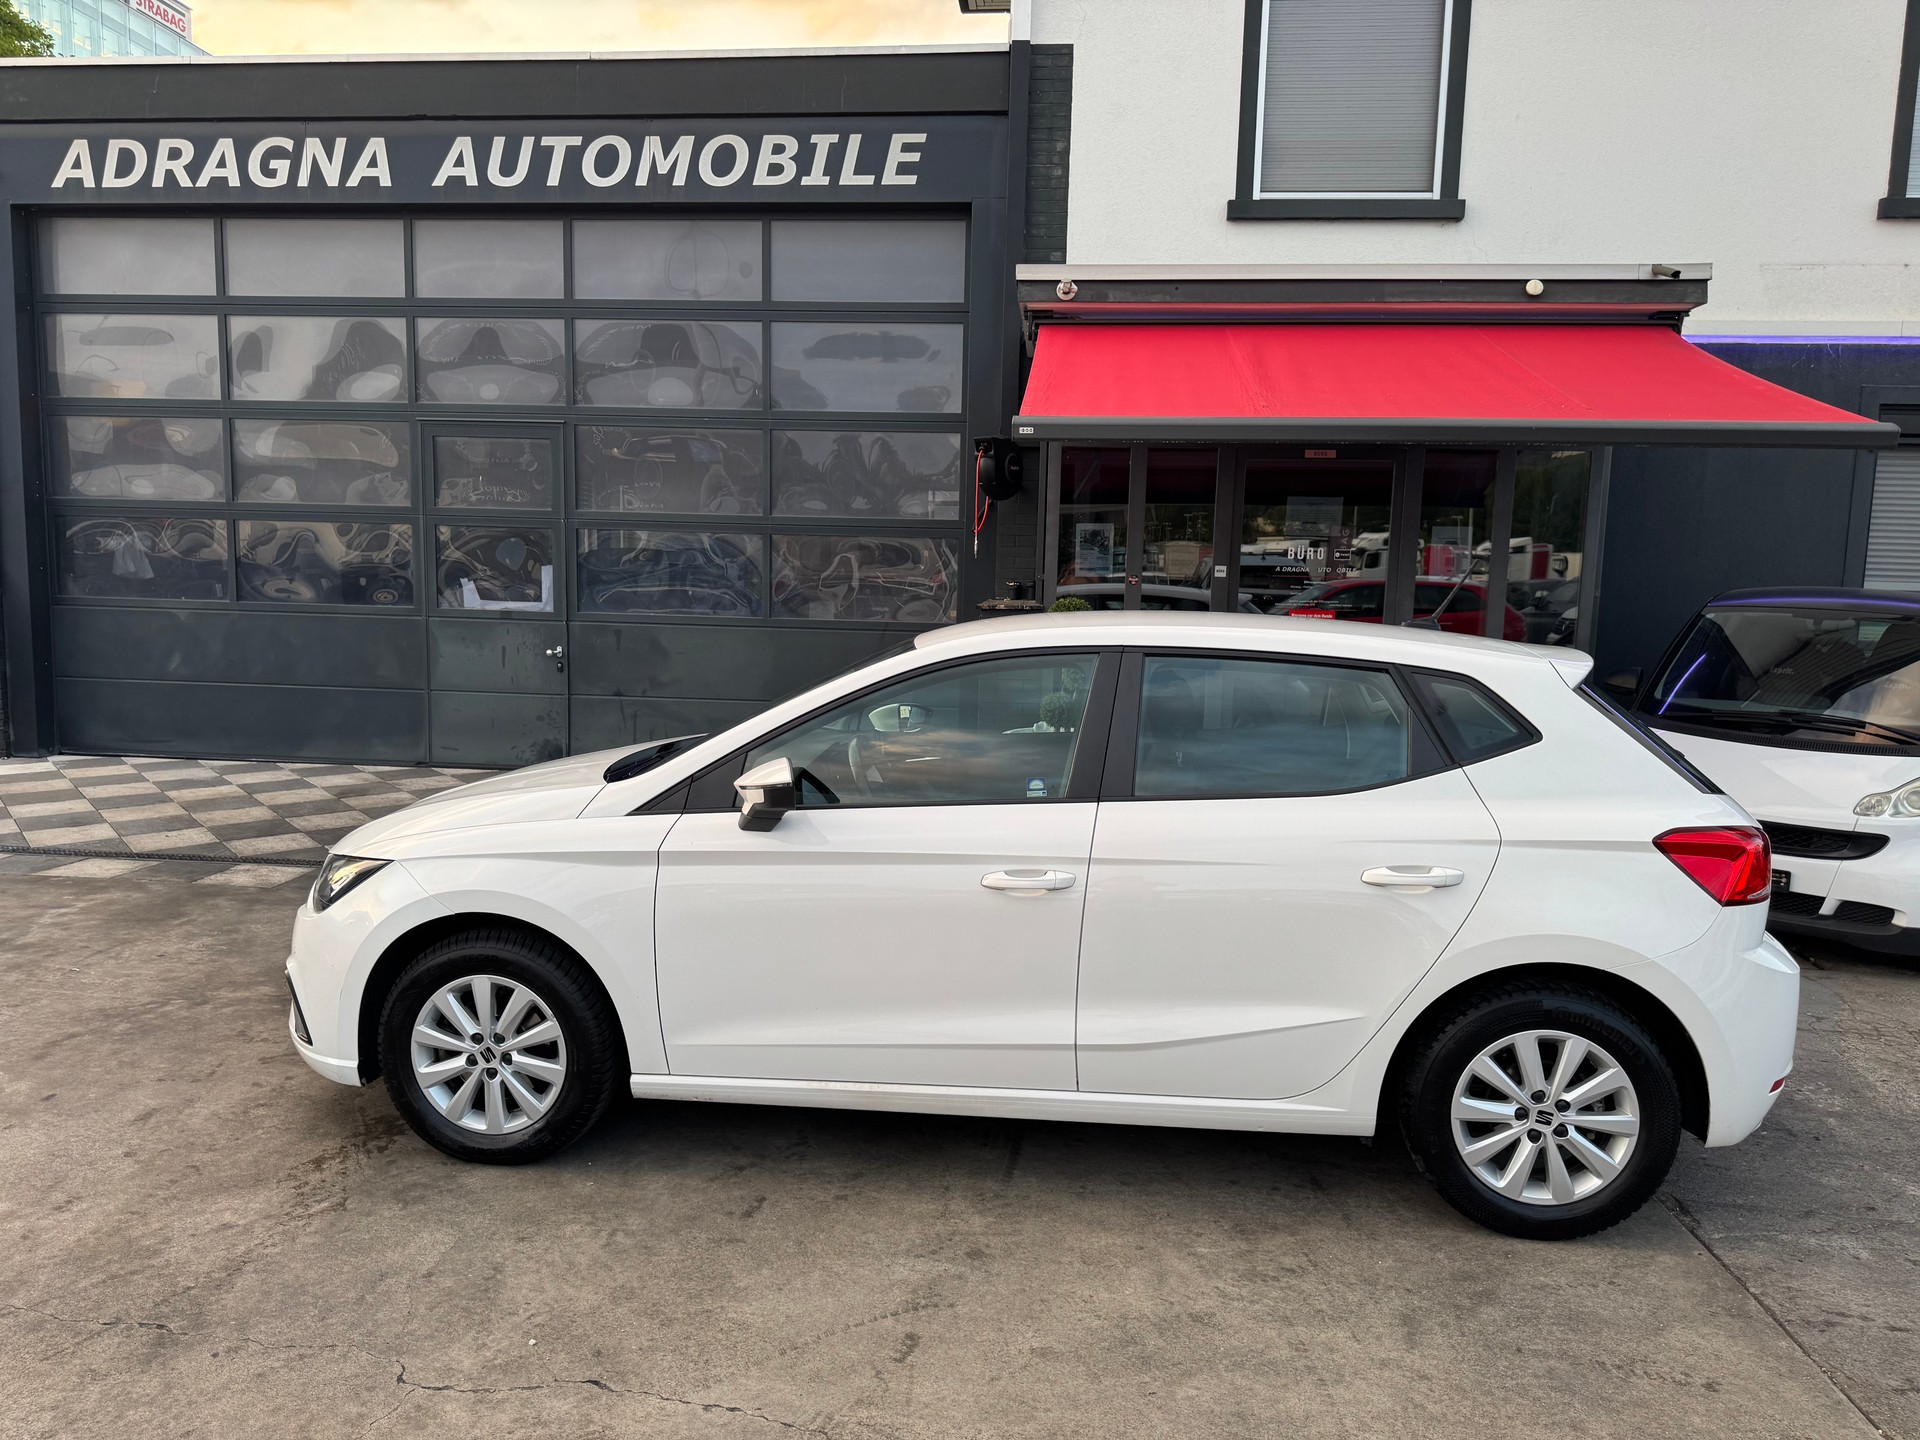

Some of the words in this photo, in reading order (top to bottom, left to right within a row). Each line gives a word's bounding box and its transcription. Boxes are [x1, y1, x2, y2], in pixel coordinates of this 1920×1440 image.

[136, 0, 186, 33] STRABAG
[51, 136, 392, 188] ADRAGNA
[431, 133, 928, 187] AUTOMOBILE
[1288, 545, 1324, 560] BÜRO
